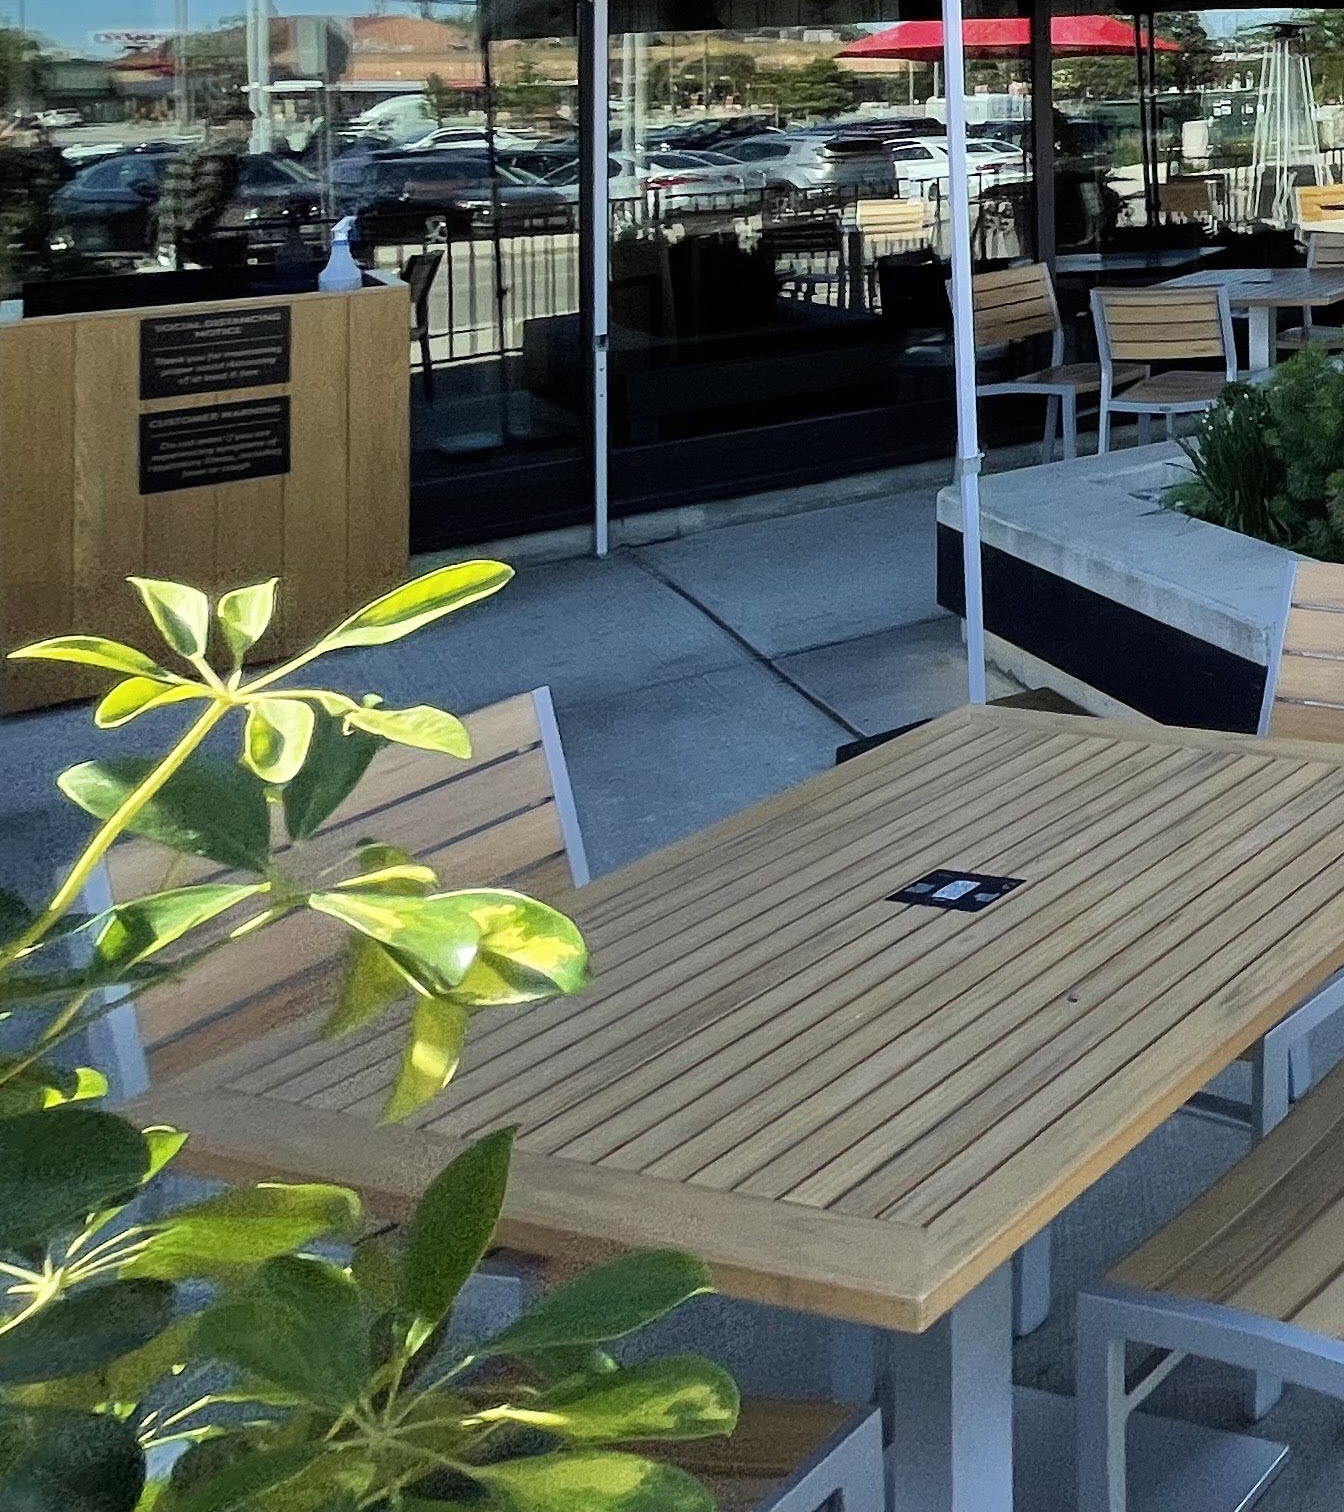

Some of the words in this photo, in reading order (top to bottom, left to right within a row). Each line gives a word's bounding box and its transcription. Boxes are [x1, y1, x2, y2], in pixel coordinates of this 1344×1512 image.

[154, 321, 203, 333] SOCIAL
[205, 312, 282, 327] DISTANCING
[194, 326, 242, 337] NOTICE
[149, 413, 219, 428] CUSTOMER
[220, 404, 281, 418] WARNING
